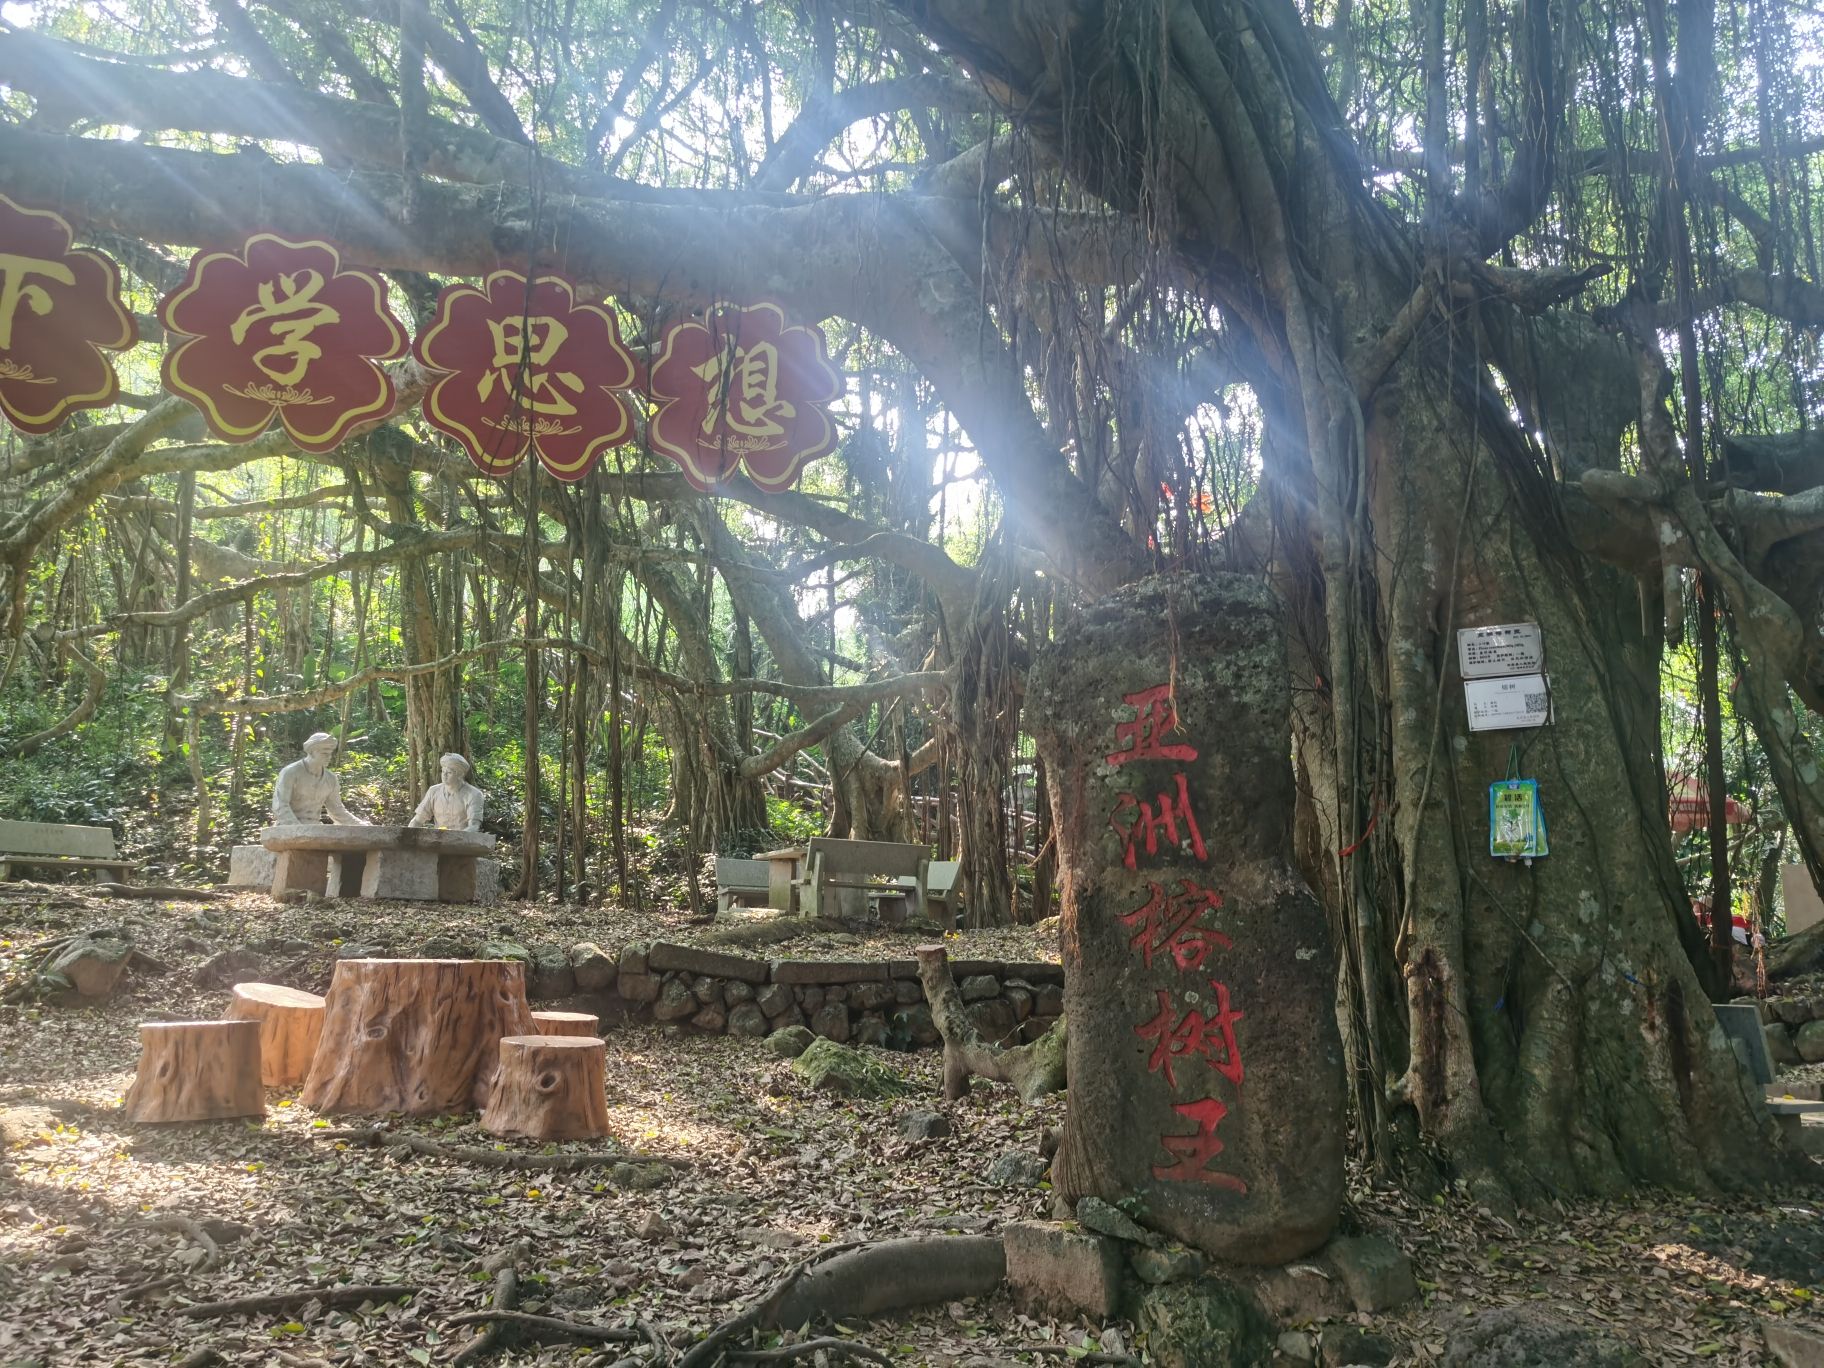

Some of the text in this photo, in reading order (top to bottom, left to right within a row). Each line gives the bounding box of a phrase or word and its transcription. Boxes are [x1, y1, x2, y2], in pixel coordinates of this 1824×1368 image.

[1106, 682, 1248, 1195] 亚洲榕树王
